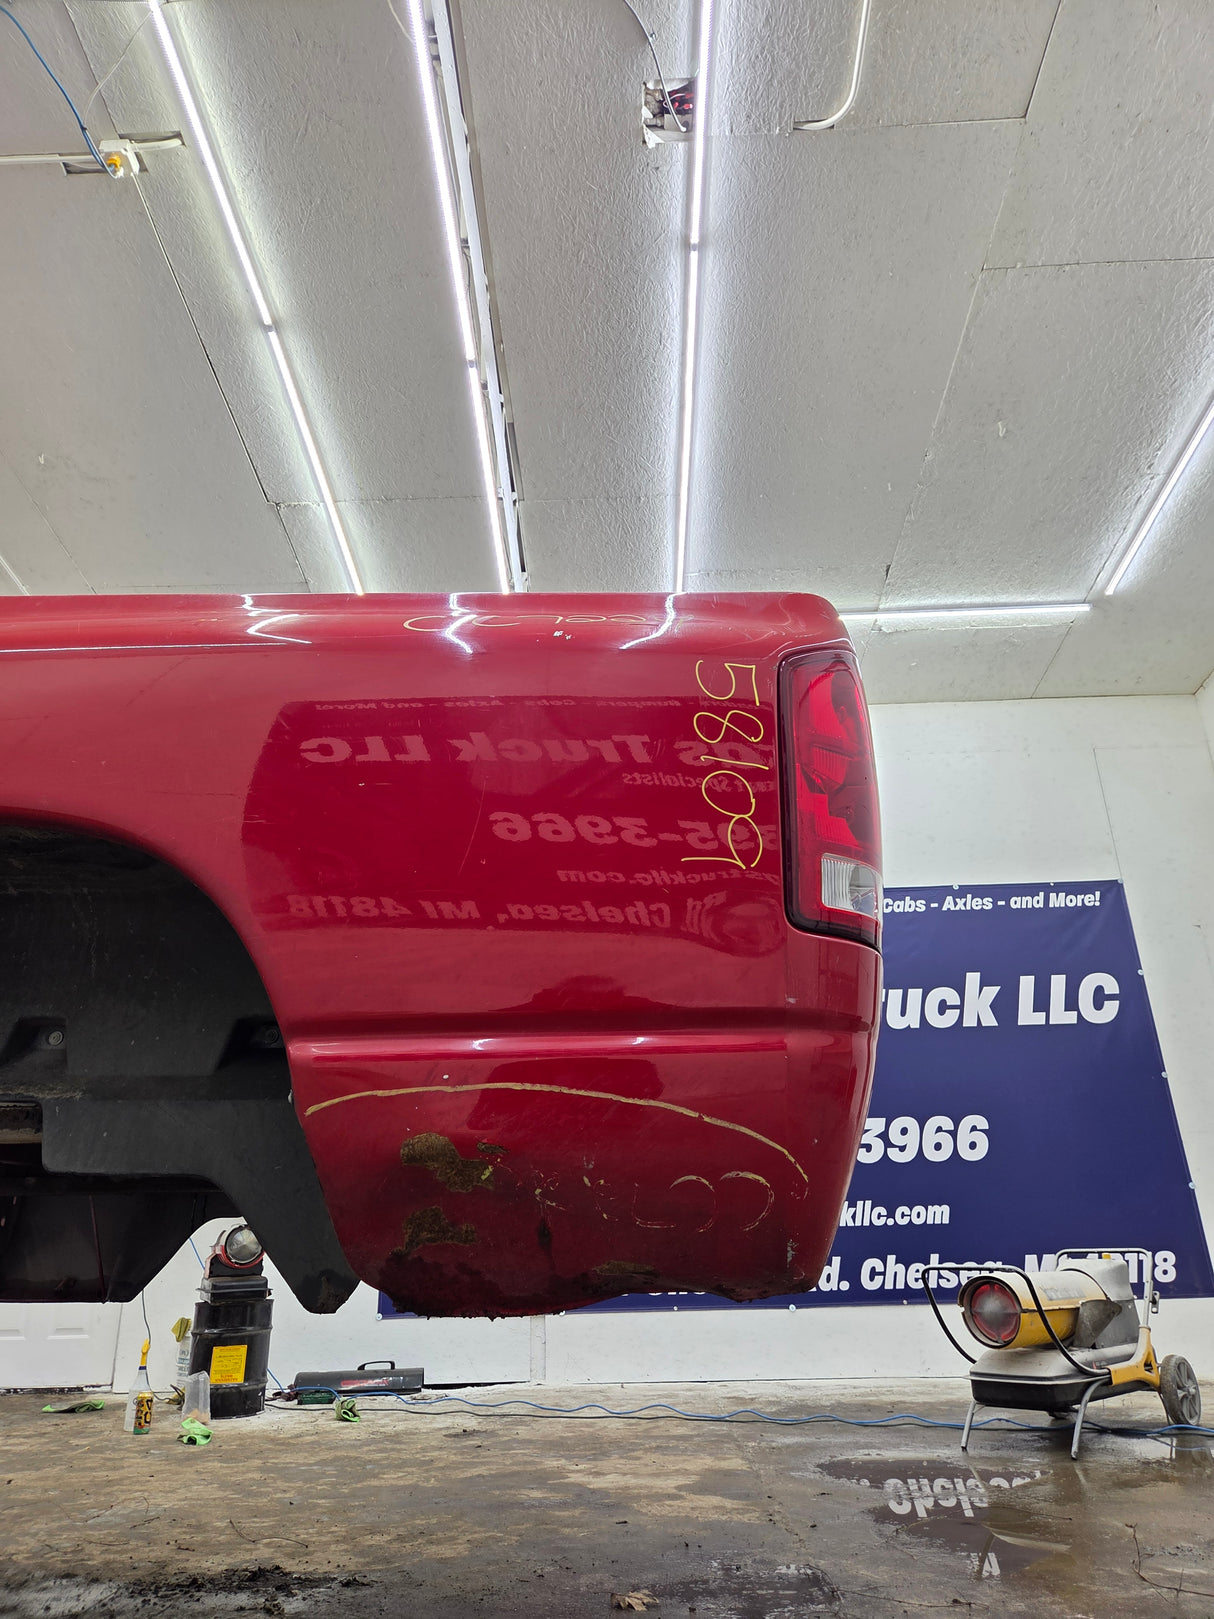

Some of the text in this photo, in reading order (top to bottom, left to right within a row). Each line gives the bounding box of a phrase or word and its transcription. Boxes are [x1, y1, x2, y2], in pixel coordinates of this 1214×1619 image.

[681, 660, 769, 870] 58109
[883, 896, 926, 913] Cabs
[942, 893, 993, 911] Axles
[1010, 892, 1044, 909] and
[1049, 890, 1101, 908] More!
[882, 971, 1120, 1030] uck LLC
[856, 1114, 990, 1164] 3966
[839, 1200, 950, 1227] kllc.com
[808, 1256, 850, 1292] d.
[860, 1253, 1003, 1290] Chels
[1086, 1250, 1177, 1283] 118
